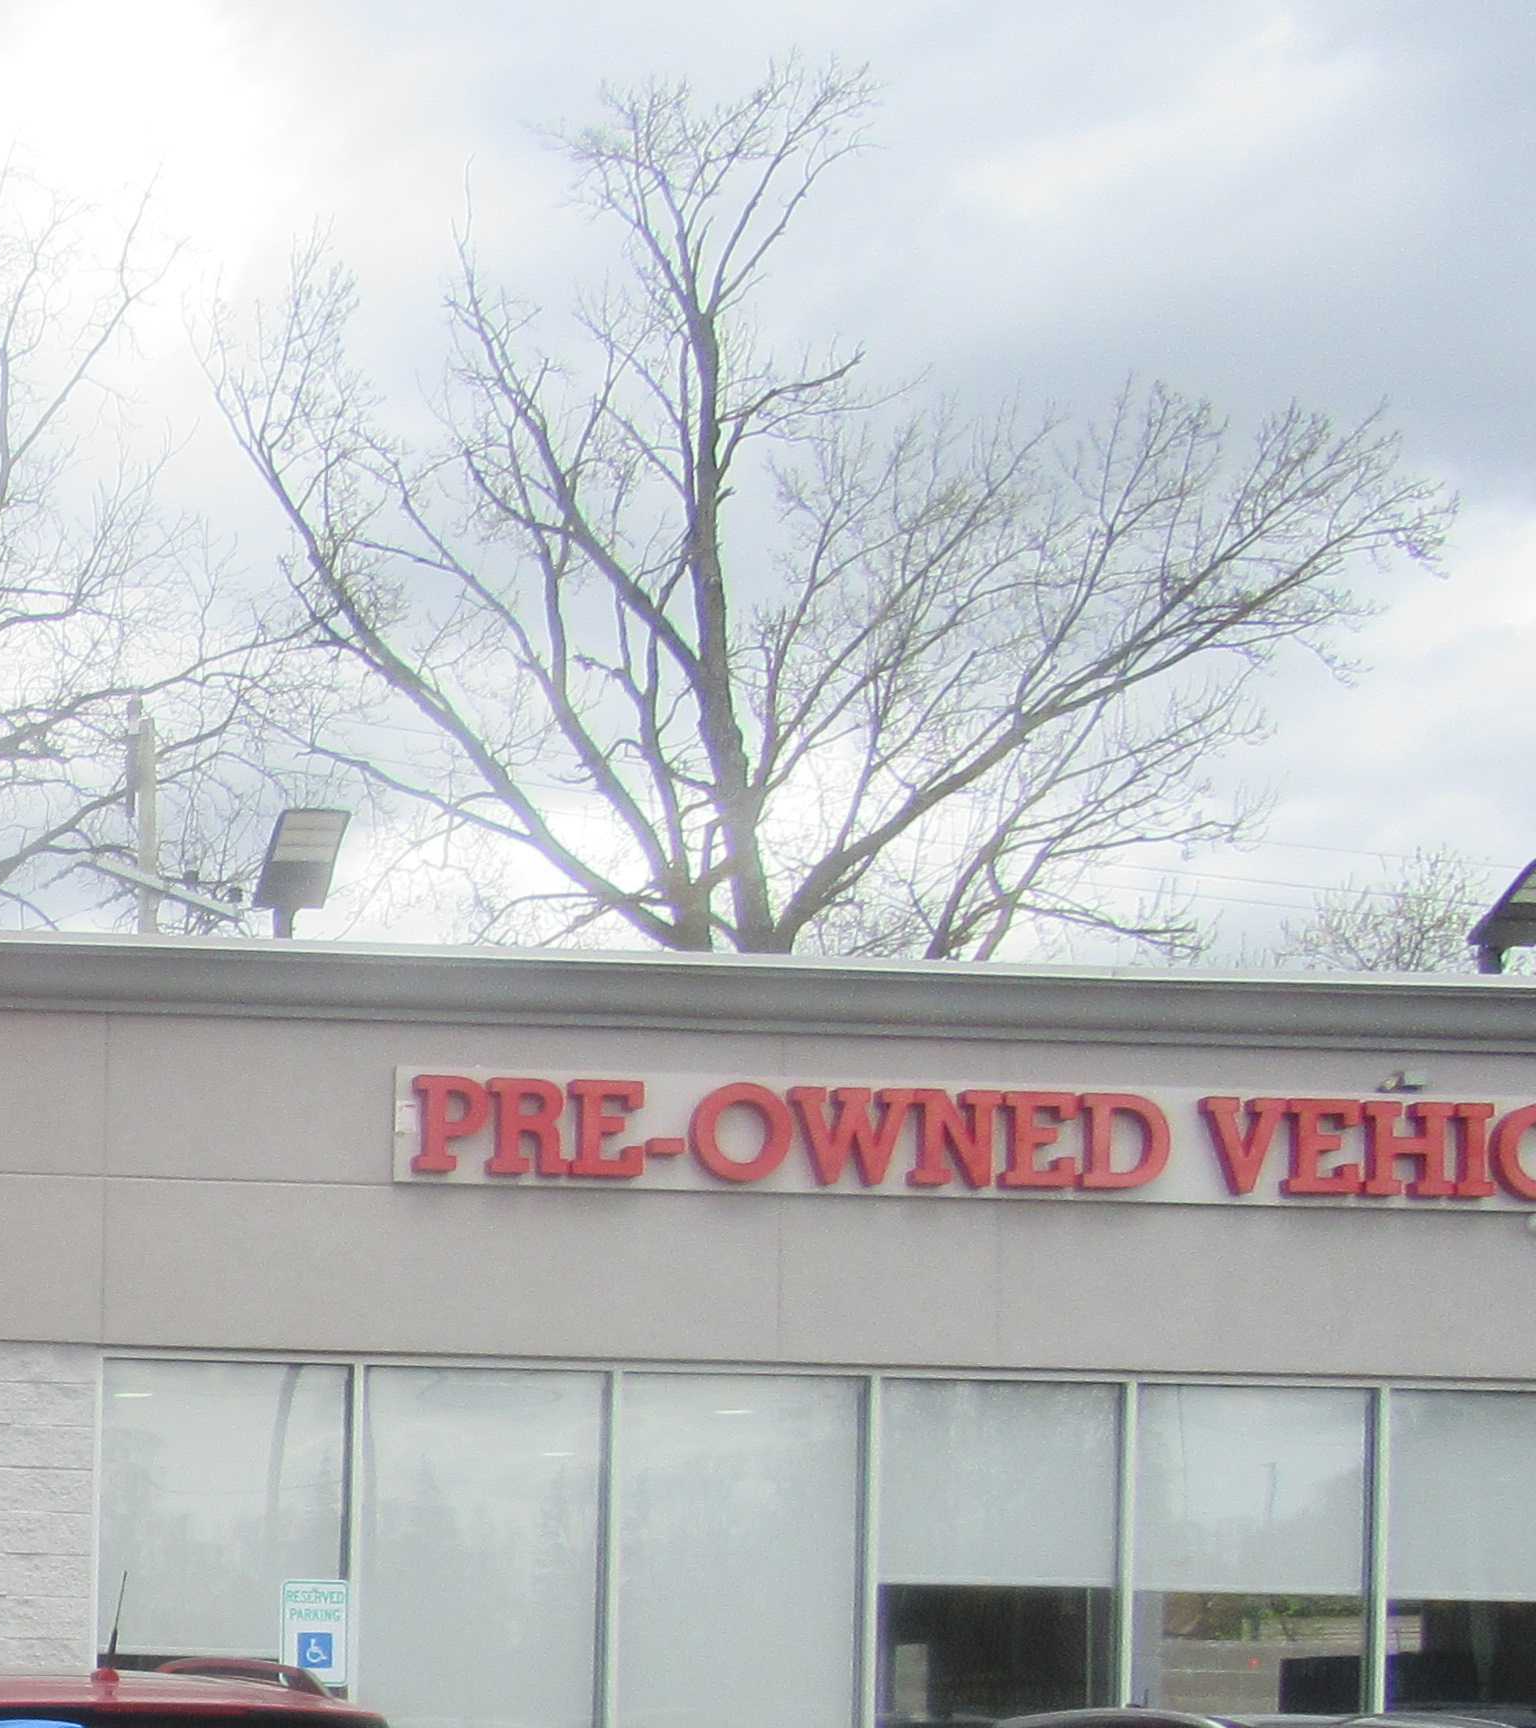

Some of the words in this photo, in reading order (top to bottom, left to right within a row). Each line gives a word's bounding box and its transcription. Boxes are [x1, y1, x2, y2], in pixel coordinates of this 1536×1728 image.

[411, 1074, 1171, 1194] PRE-OWNED
[286, 1590, 345, 1604] RESERVED
[289, 1608, 340, 1621] PARKING
